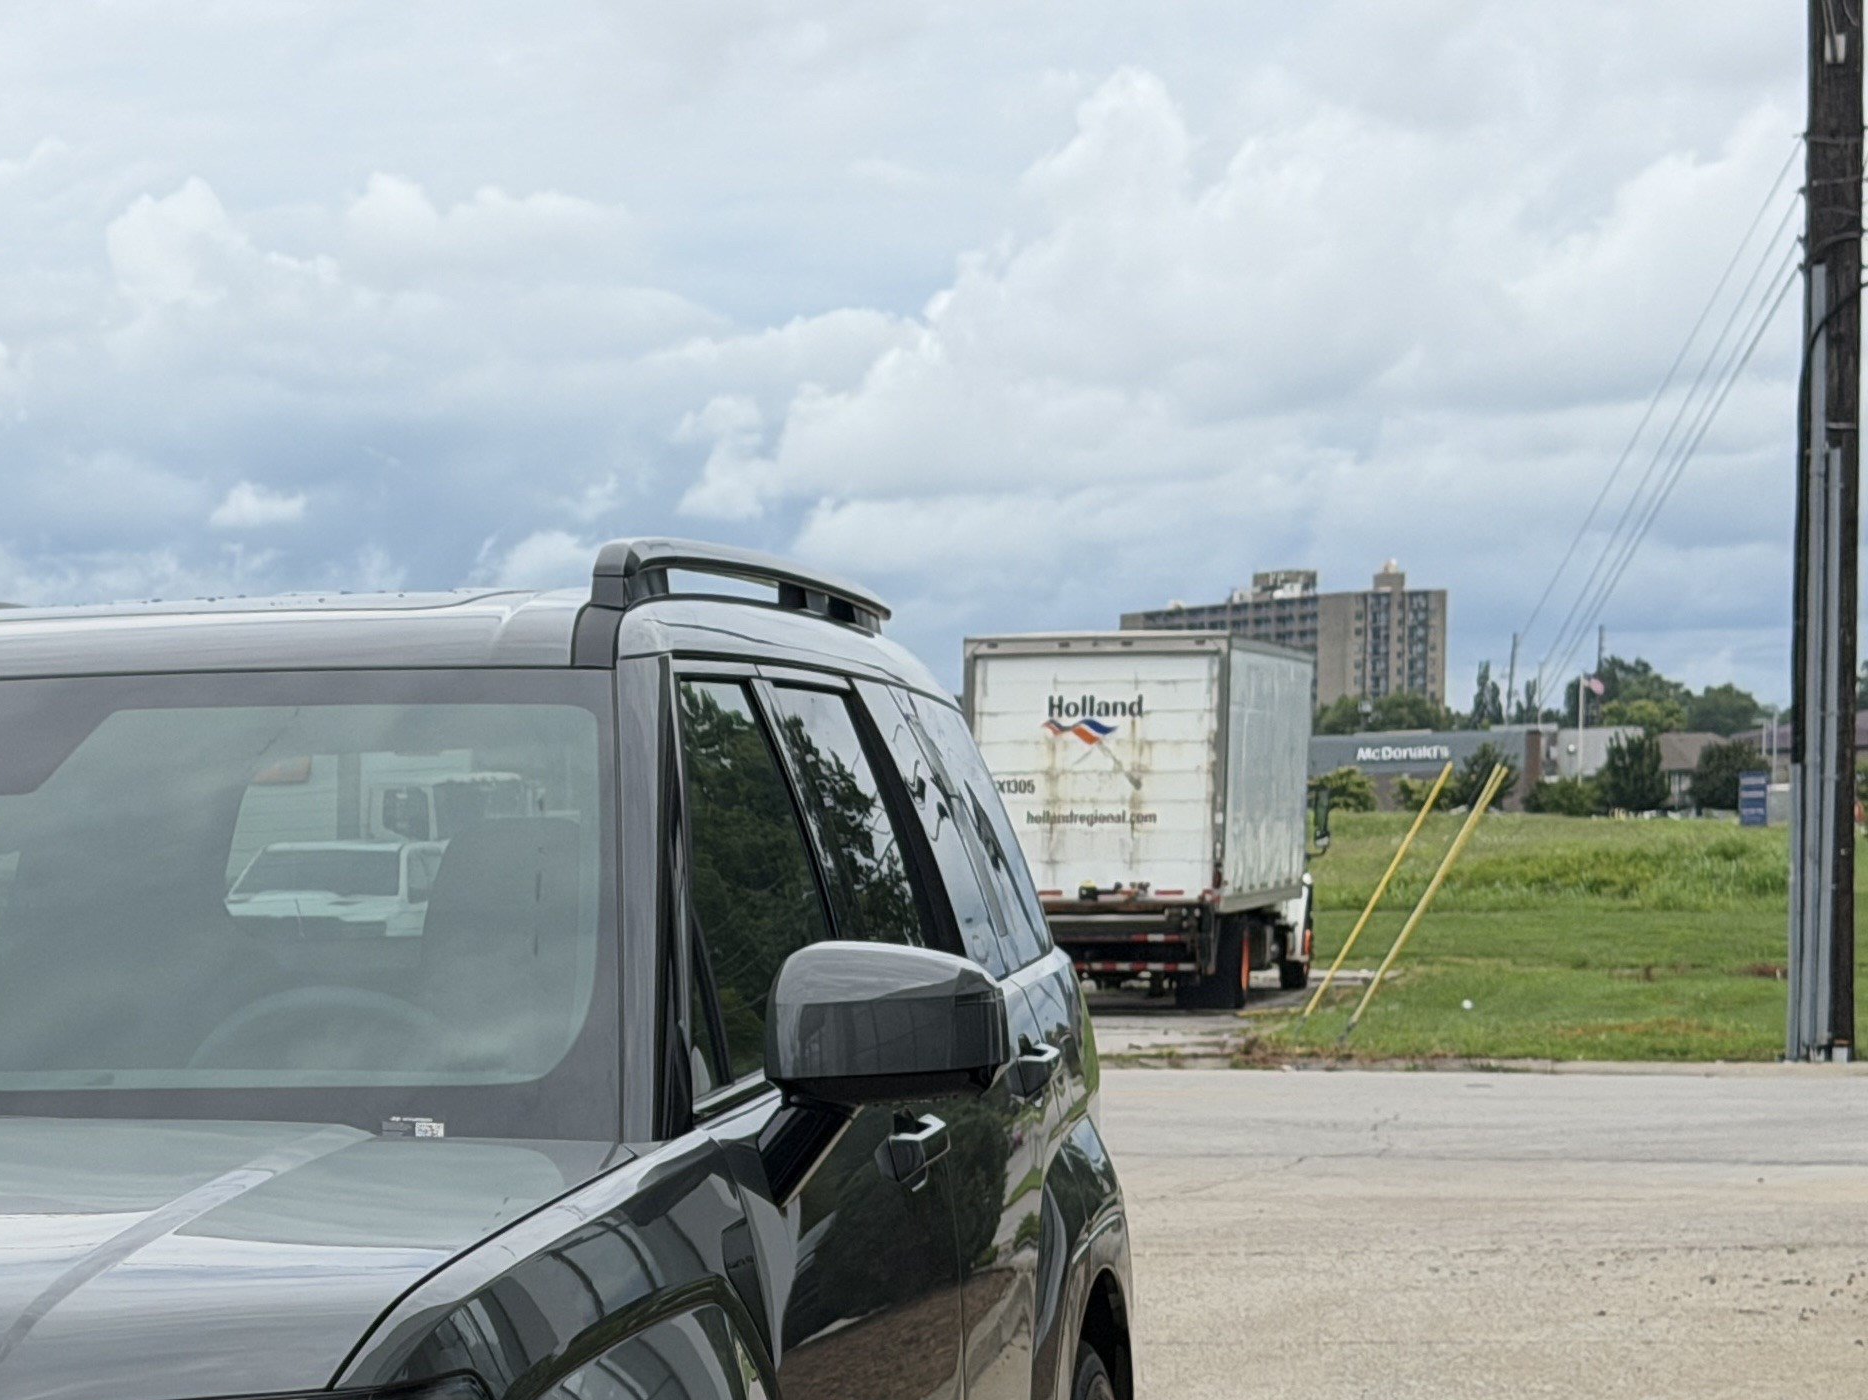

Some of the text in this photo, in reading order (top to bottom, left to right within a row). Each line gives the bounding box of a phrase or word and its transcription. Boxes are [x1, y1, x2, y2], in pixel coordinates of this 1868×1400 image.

[1048, 694, 1143, 718] Holland
[1356, 745, 1450, 761] McDonald's
[995, 779, 1036, 794] X1305
[1026, 810, 1157, 827] hollandregional.com
